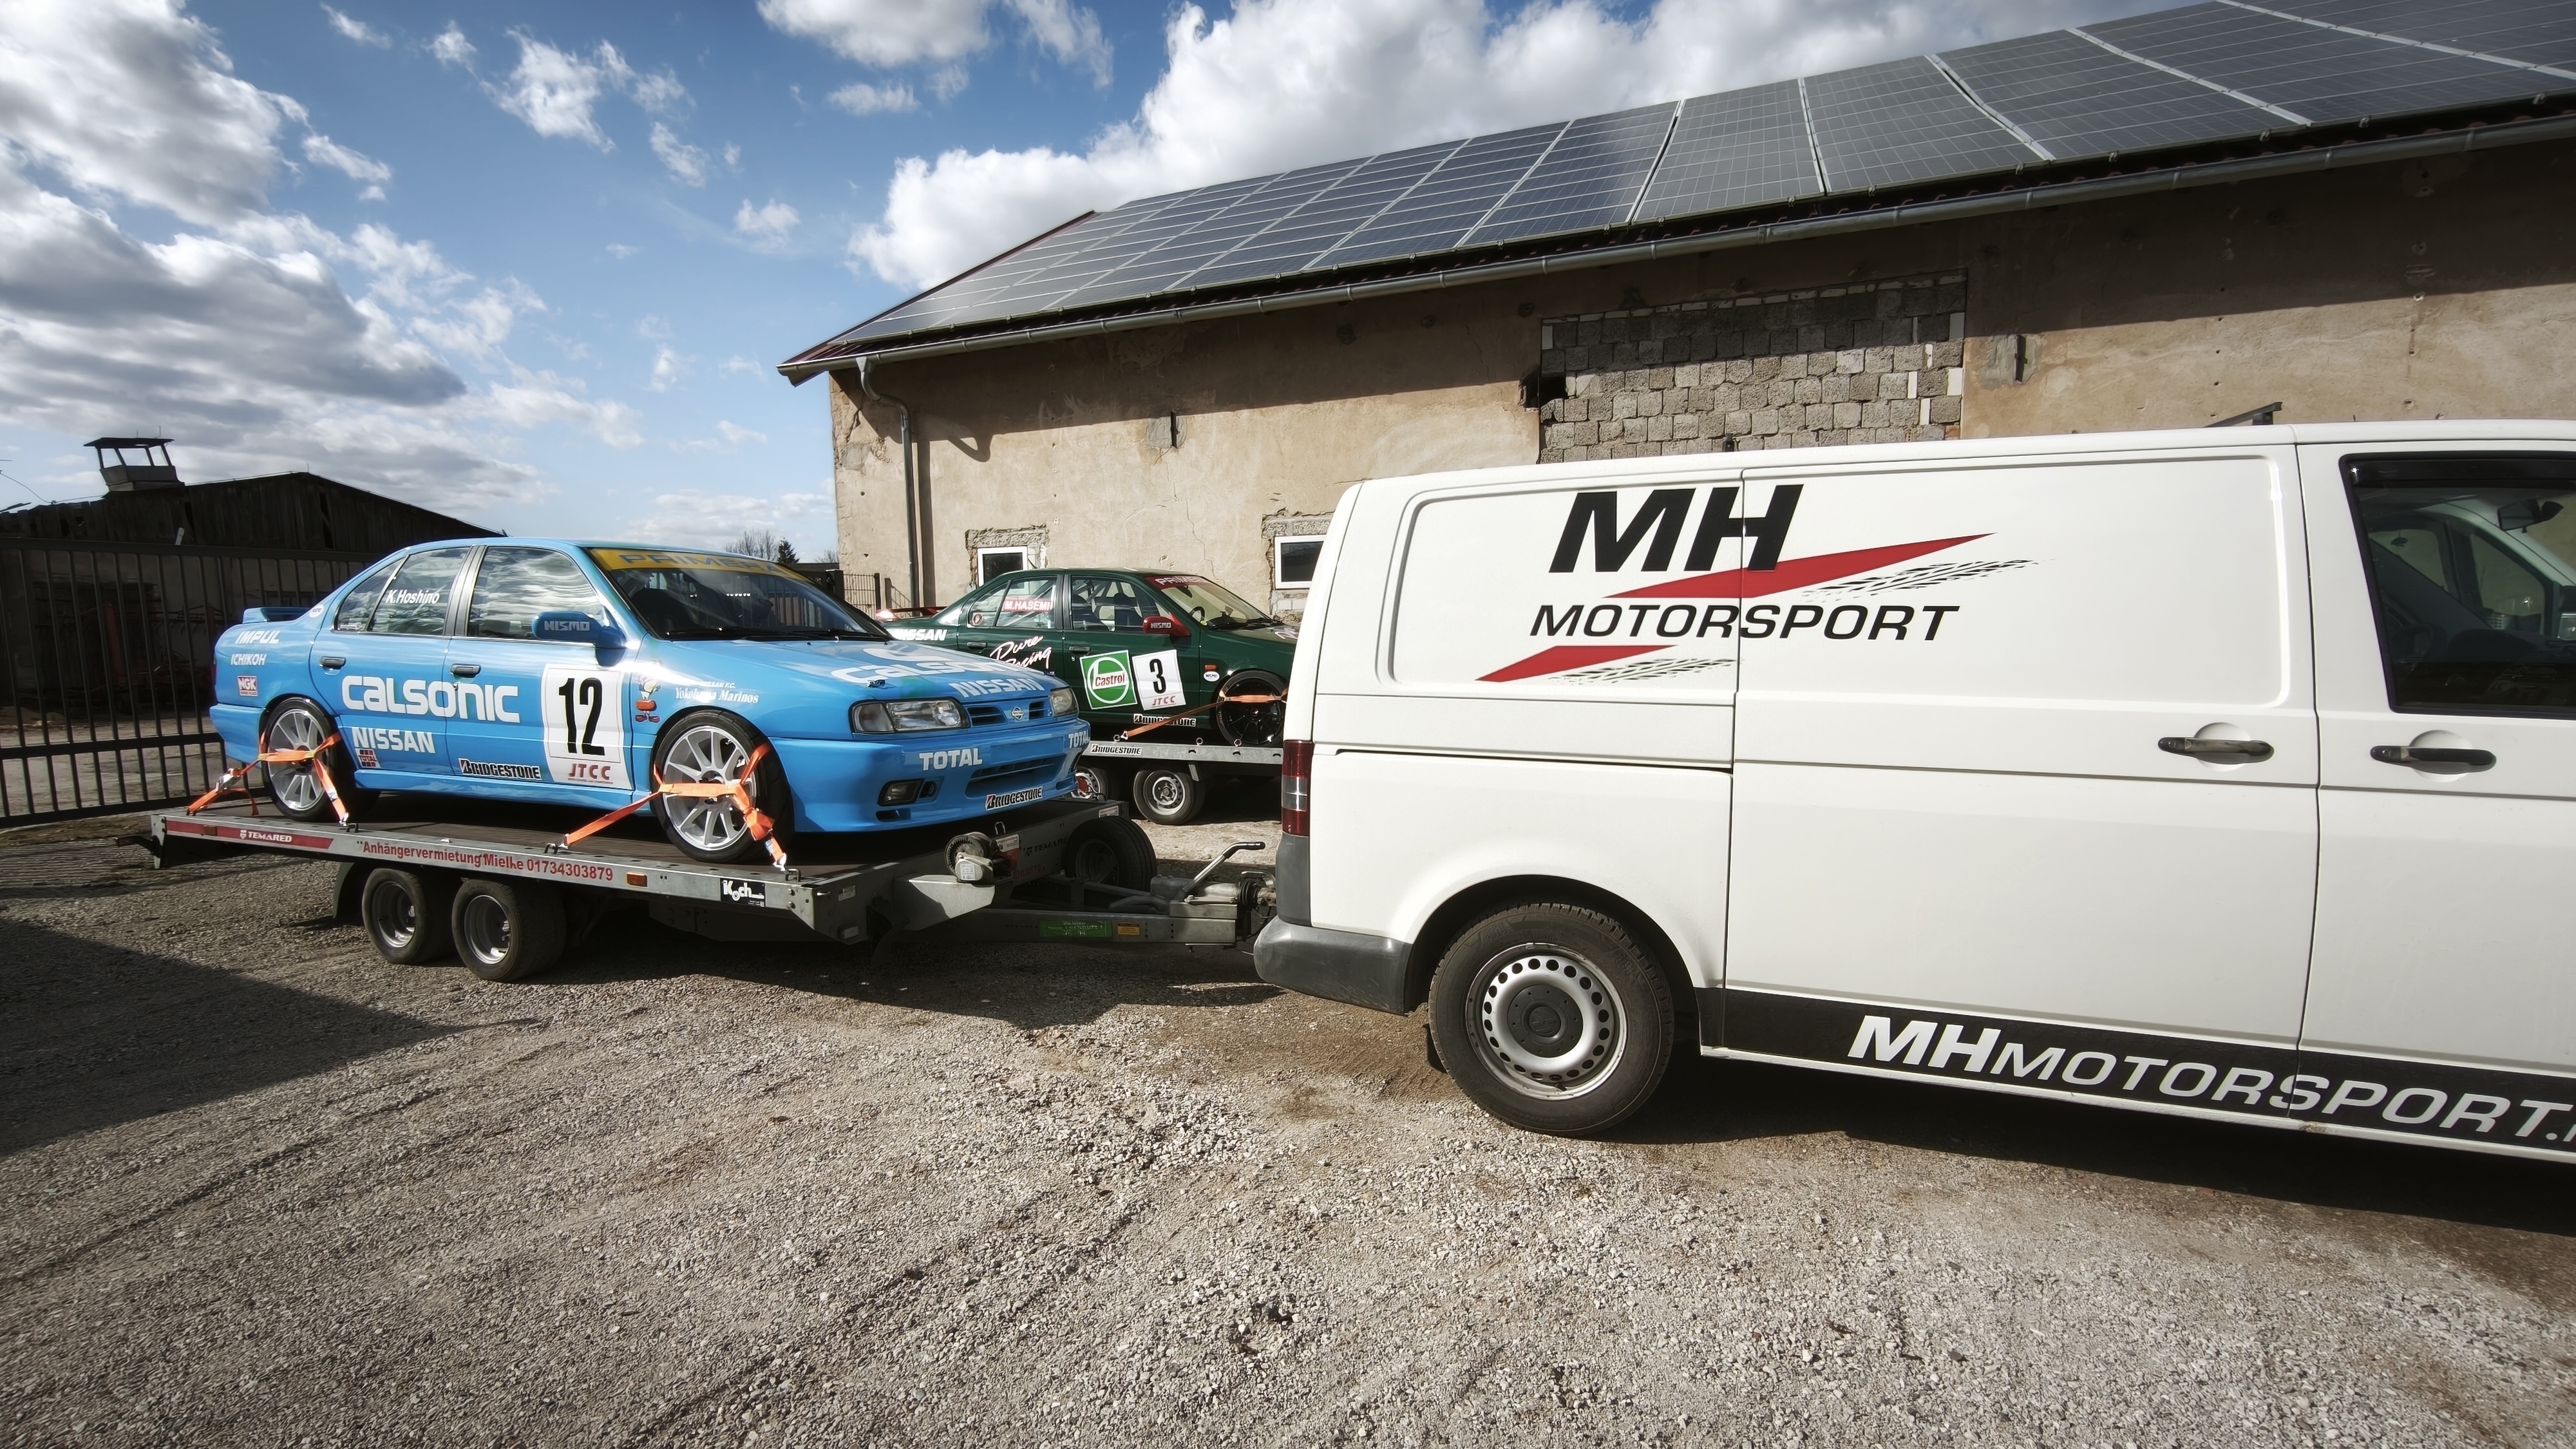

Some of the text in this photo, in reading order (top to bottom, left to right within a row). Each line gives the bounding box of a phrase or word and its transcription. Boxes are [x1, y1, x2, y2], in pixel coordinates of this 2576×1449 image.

[1549, 484, 1804, 573] MH
[386, 589, 440, 604] K.Hoshino
[544, 621, 590, 631] NISMO
[1530, 605, 1960, 641] MOTORSPORT
[235, 630, 281, 644] IMPUL
[231, 654, 267, 666] ICHIKOH
[238, 677, 257, 690] NGK
[1095, 673, 1125, 687] Castrol
[1150, 658, 1166, 694] 3
[719, 690, 759, 704] Marinos
[948, 678, 1045, 698] NISSAN
[558, 677, 605, 755] 12
[352, 727, 435, 753] NISSAN
[1092, 745, 1141, 755] BRIDGESTONE
[460, 759, 541, 779] BRIDGESTONE
[919, 748, 983, 771] TOTAL
[568, 764, 611, 781] JTCC
[986, 787, 1043, 809] BRIDGESTONE
[248, 831, 292, 842] TEMARED
[363, 841, 480, 867] Anhängervermietung
[527, 858, 613, 881] 01734303879
[723, 880, 759, 901] Koch
